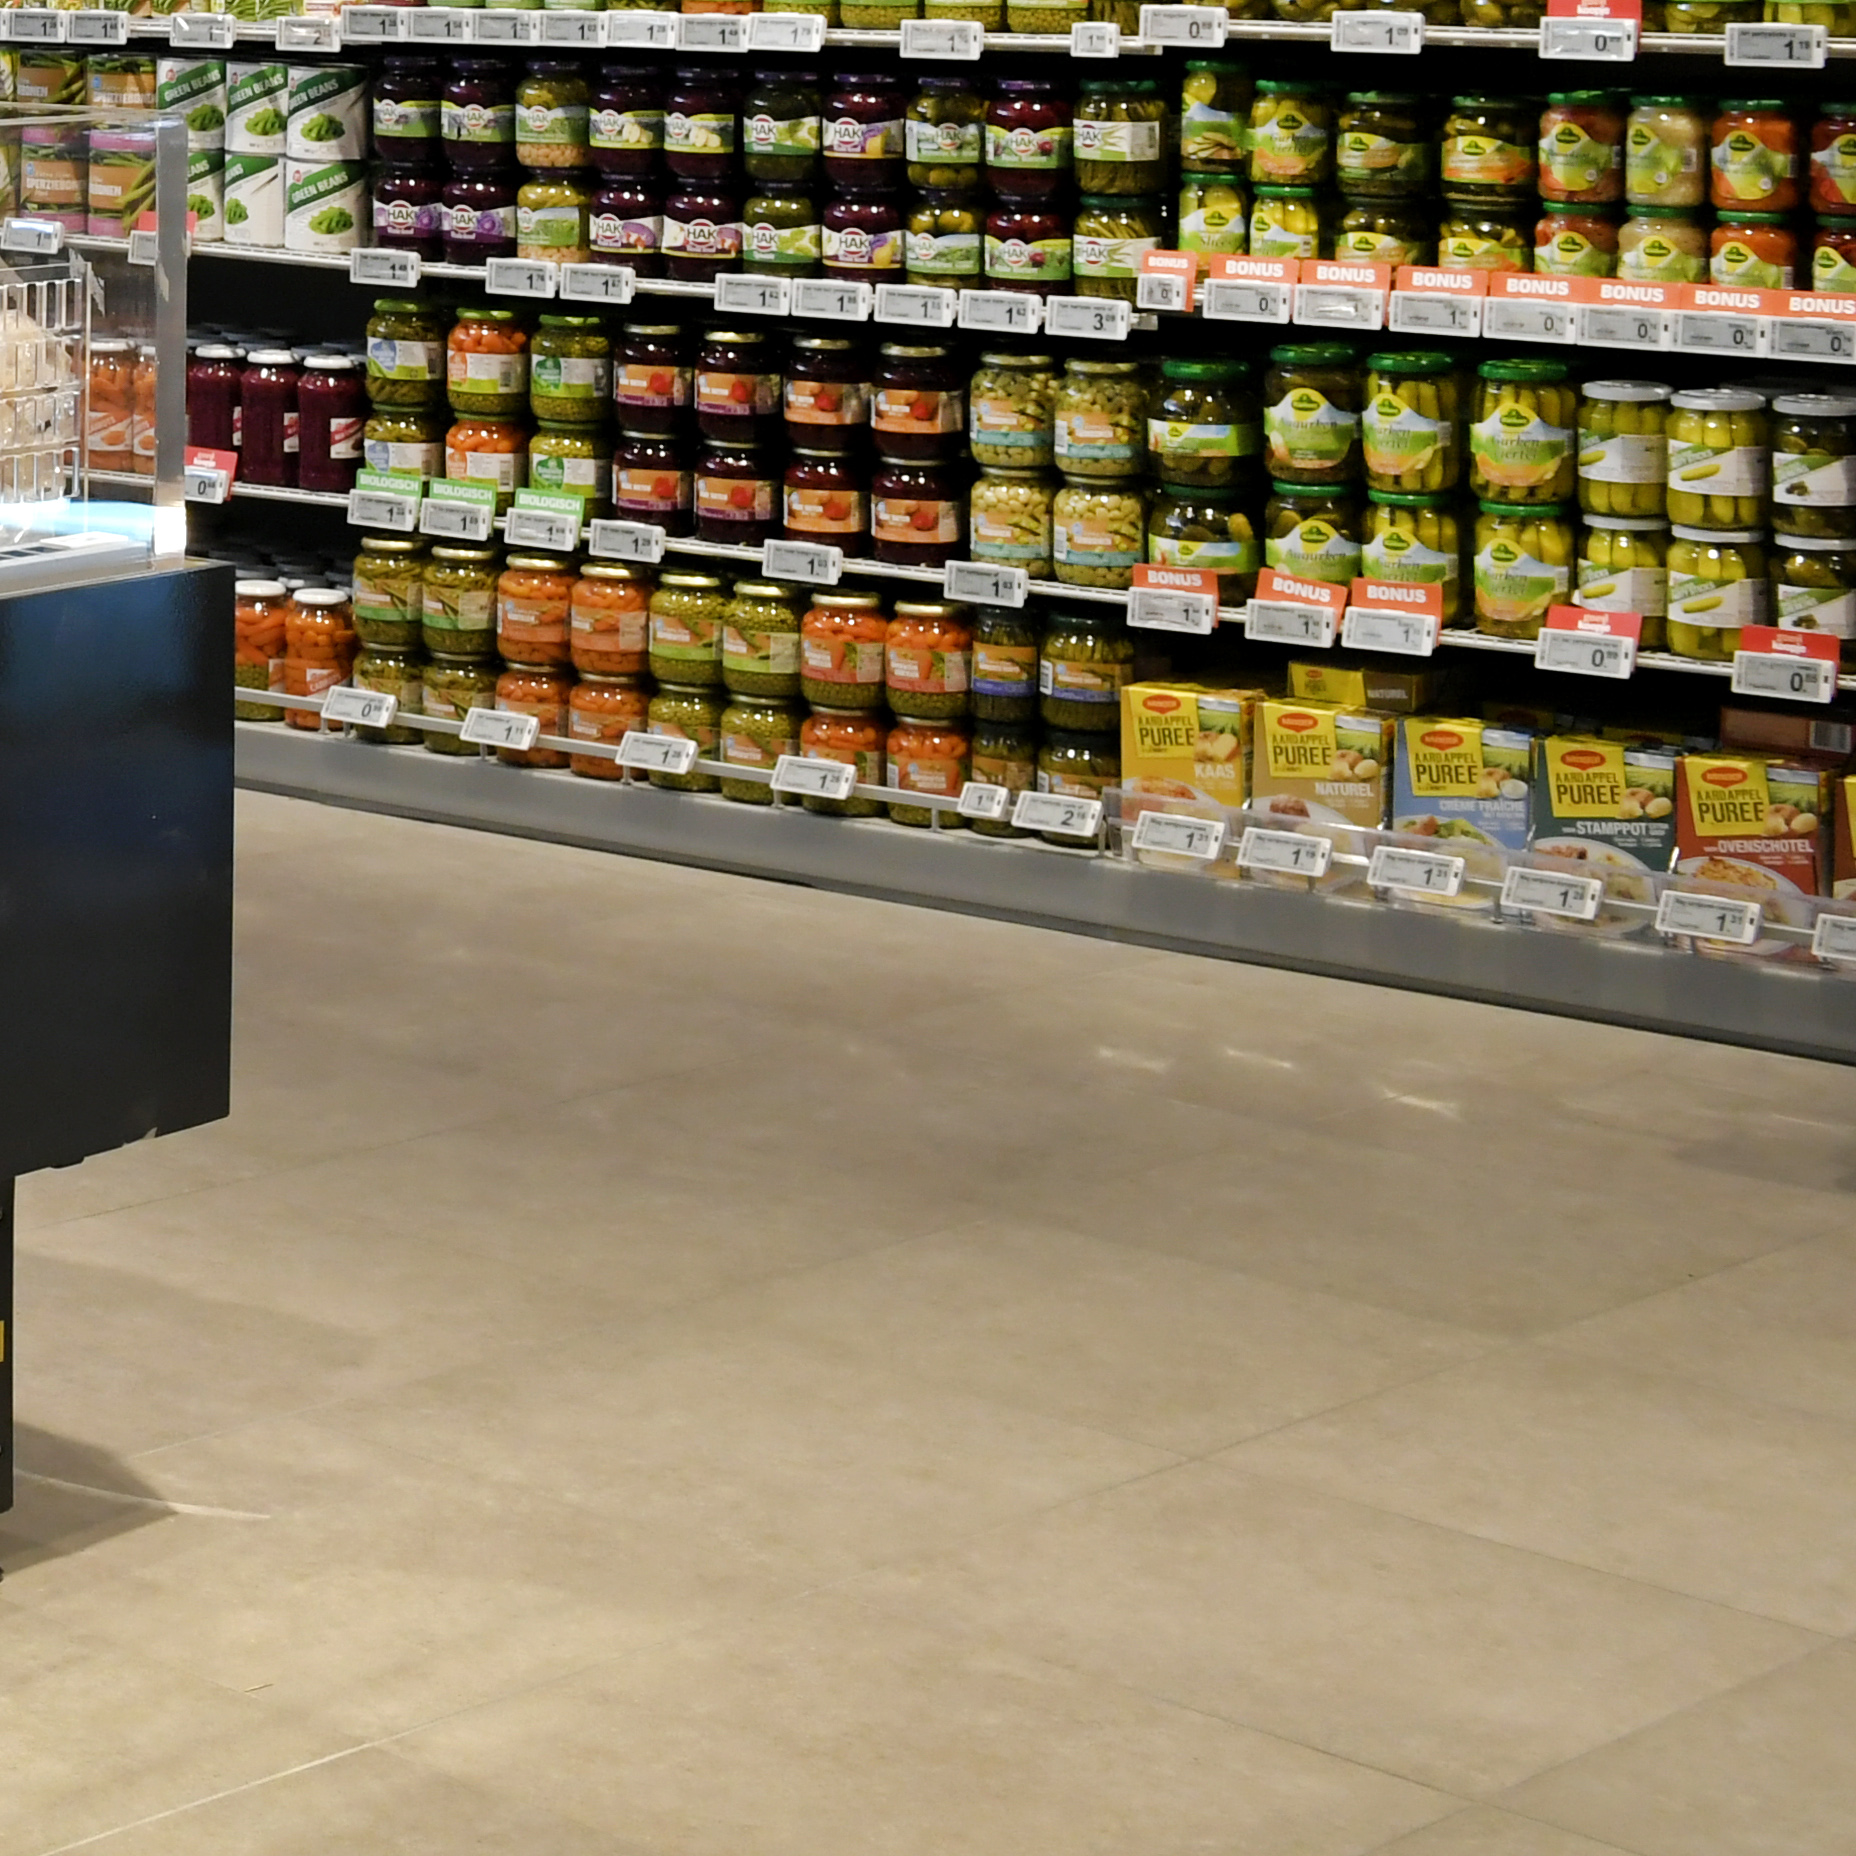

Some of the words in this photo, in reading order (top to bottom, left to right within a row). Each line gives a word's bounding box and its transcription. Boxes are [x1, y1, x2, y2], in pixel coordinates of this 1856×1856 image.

[164, 82, 190, 102] GREEN
[190, 68, 220, 91] BEANS
[254, 73, 284, 95] BEANS
[309, 78, 338, 99] BEANS
[752, 123, 777, 137] HAK
[833, 126, 861, 141] HAK
[291, 183, 316, 202] GREEN
[318, 171, 348, 191] BEANS
[388, 211, 416, 223] HAK
[688, 227, 717, 240] HAK
[752, 231, 778, 246] HAK
[839, 237, 870, 252] HAK
[1148, 257, 1188, 269] BONUS
[1225, 260, 1283, 277] BONUS
[1316, 265, 1375, 283] BONUS
[1412, 271, 1473, 289] BONUS
[1506, 278, 1569, 295] BONUS
[1600, 284, 1664, 302] BONUS
[1694, 290, 1760, 308] BONUS
[1789, 297, 1856, 315] BONUS
[360, 474, 419, 491] BIOLOGISCH
[434, 483, 493, 500] BIOLOGISCH
[519, 494, 580, 511] BIOLOGISCH
[1146, 569, 1203, 588] BONUS
[1271, 577, 1332, 603] BONUS
[1365, 583, 1428, 604] BONUS
[1138, 716, 1193, 727] AARDAPPEL
[1139, 727, 1195, 746] PUREE
[1272, 734, 1330, 746] AARDAPPEL
[1273, 746, 1331, 766] PUREE
[1415, 752, 1476, 764] AARDAPPEL
[1194, 763, 1235, 779] KAAS
[1416, 764, 1478, 785] PUREE
[1555, 773, 1619, 784] AARDAPPEL
[1315, 782, 1374, 797] NATUREL
[1557, 785, 1621, 805] PUREE
[1697, 790, 1762, 801] AARDAPPEL
[1699, 802, 1764, 824] PUREE
[1576, 821, 1648, 836] STAMPPOT
[1718, 840, 1814, 853] OVENSCHOTEL
